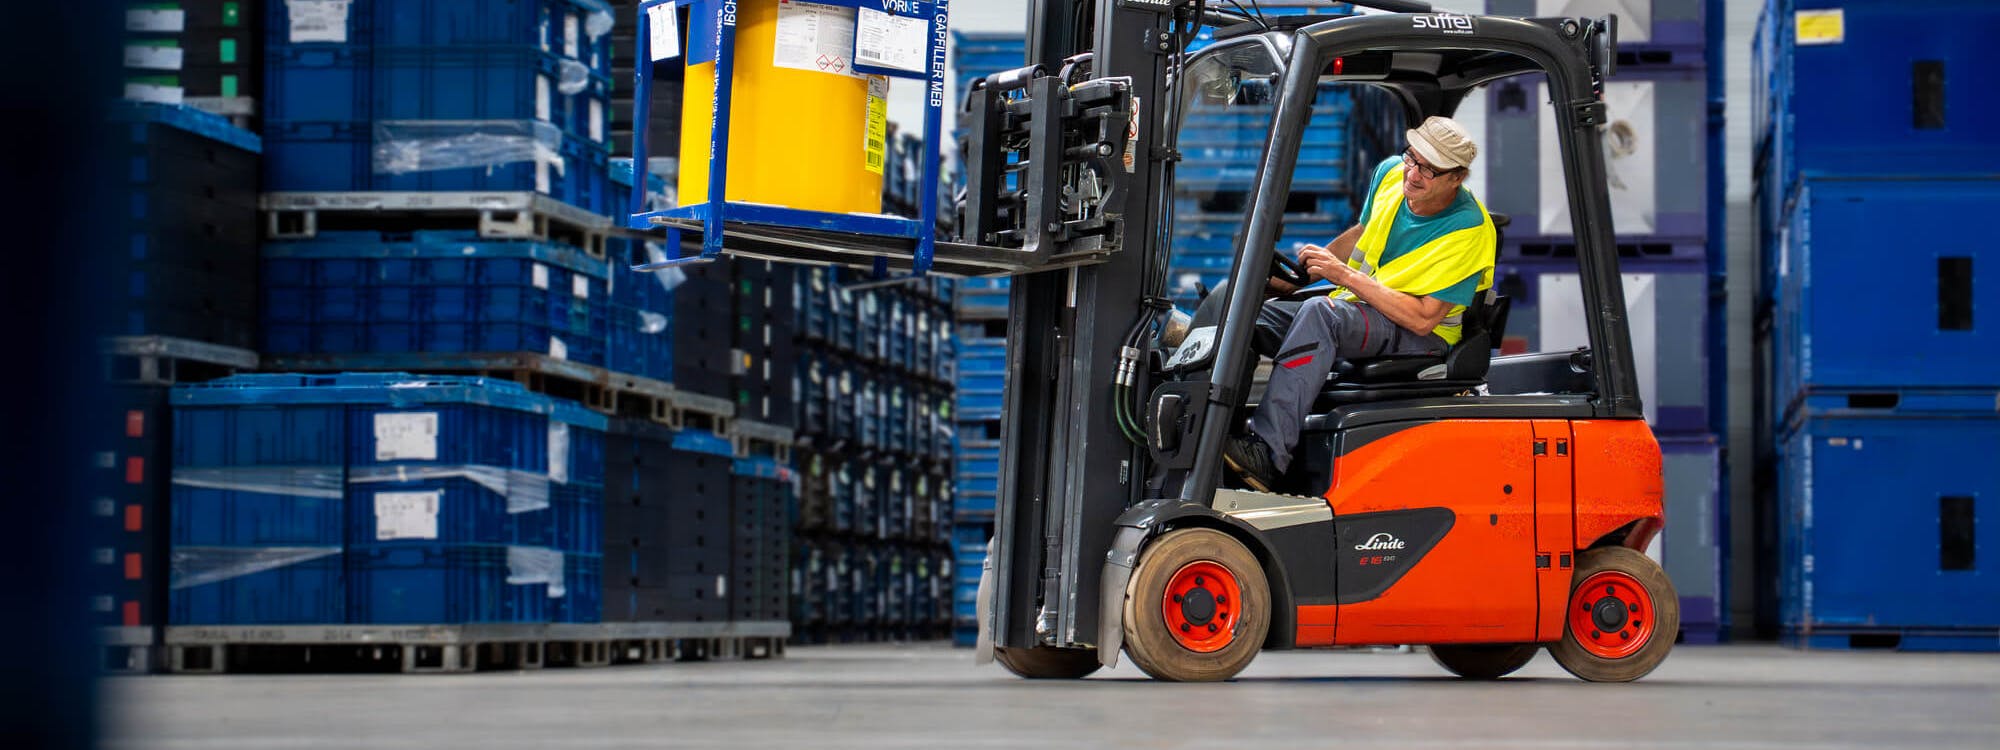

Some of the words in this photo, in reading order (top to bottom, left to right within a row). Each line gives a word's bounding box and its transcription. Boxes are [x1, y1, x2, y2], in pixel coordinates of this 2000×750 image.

[882, 0, 920, 14] VORNE
[1412, 13, 1473, 29] suffel
[931, 14, 947, 79] GAPFILLER
[930, 81, 943, 107] MEB
[1355, 532, 1406, 550] Linde
[1371, 555, 1383, 565] 16
